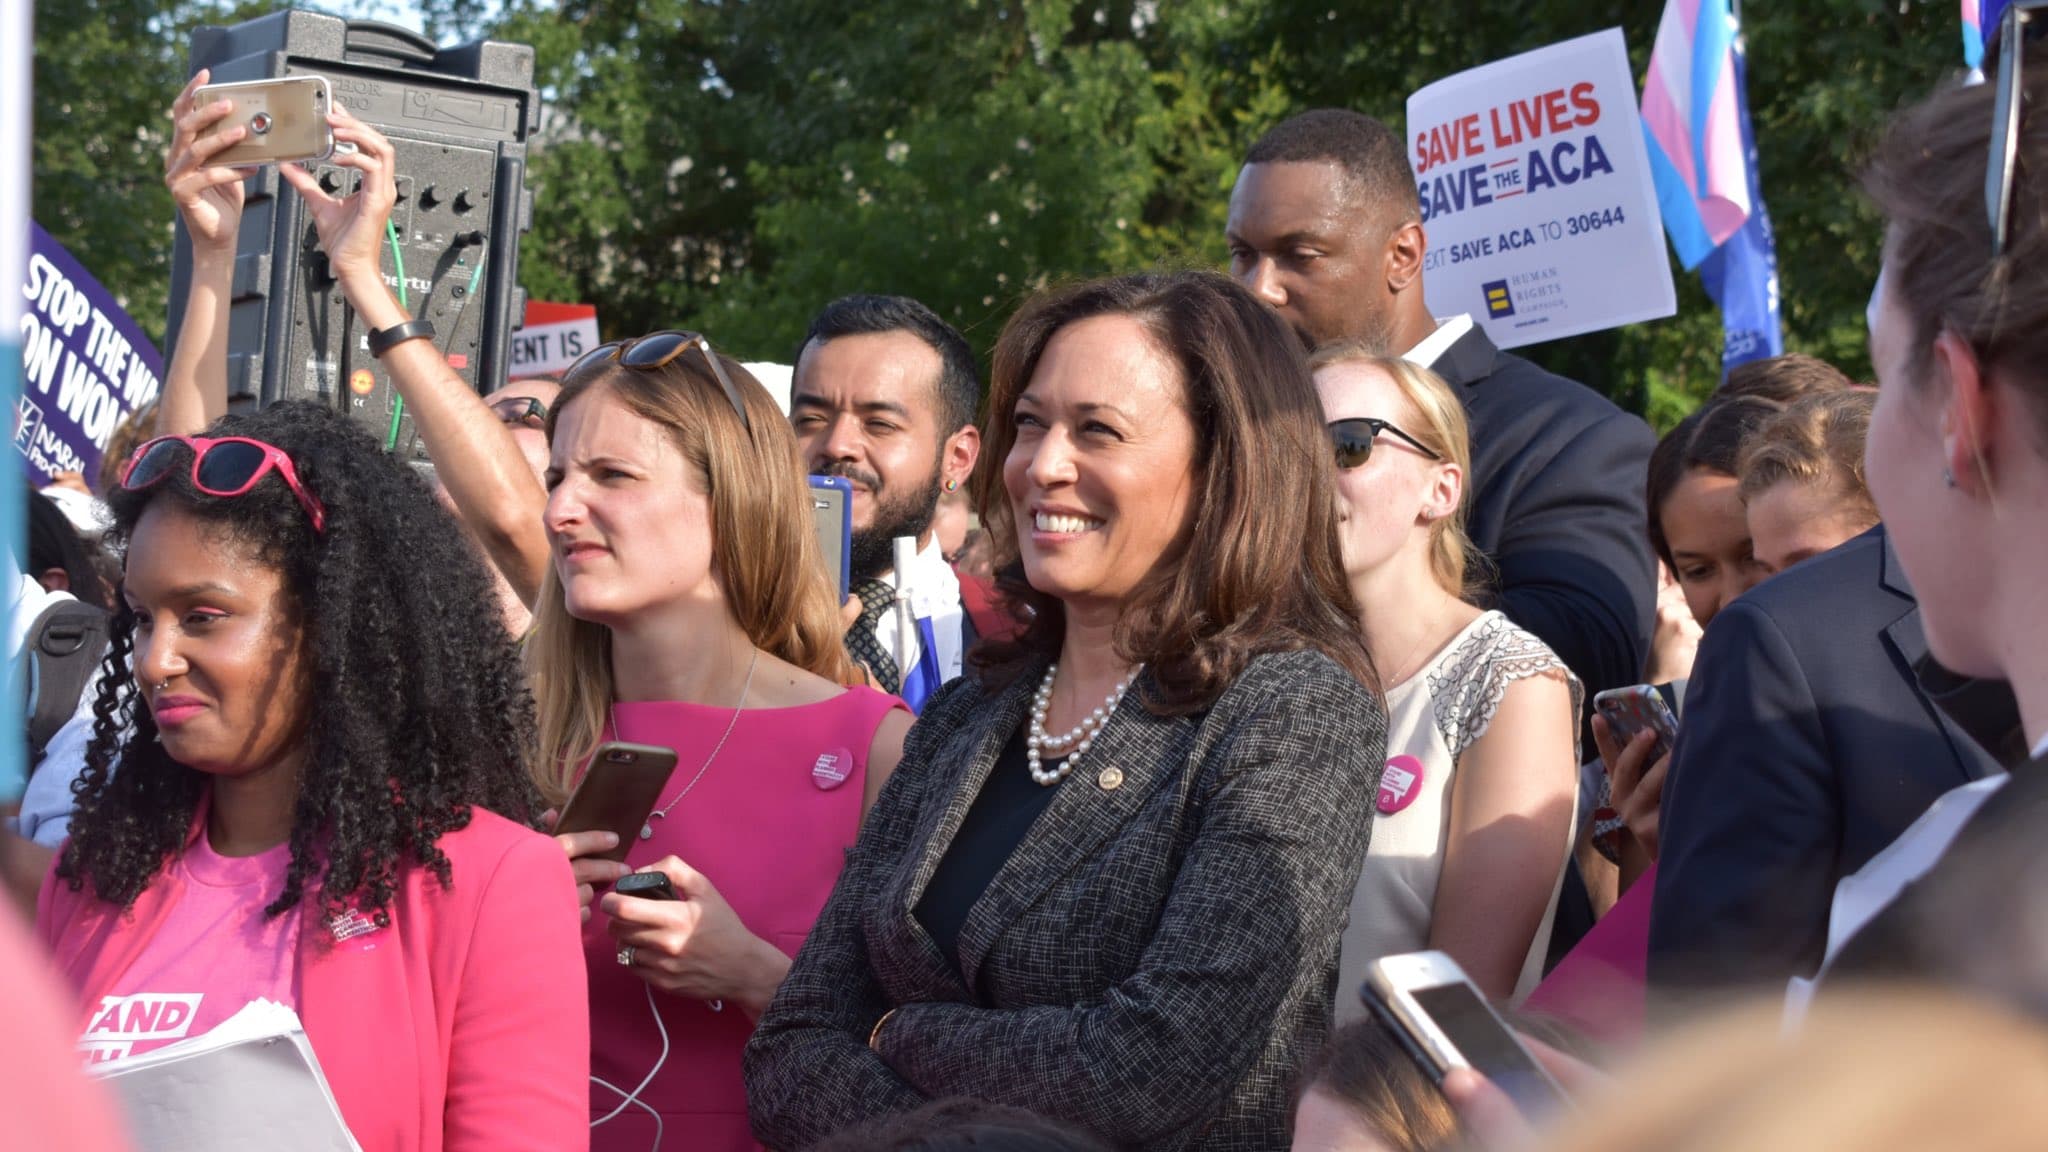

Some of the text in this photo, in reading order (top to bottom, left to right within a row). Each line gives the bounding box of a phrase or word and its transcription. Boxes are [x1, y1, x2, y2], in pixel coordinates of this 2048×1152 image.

[1417, 82, 1600, 174] SAVE LIVES
[1420, 135, 1614, 223] SAVE THE ACA
[1426, 206, 1625, 271] EXT SAVE ACA TO 30644
[20, 312, 64, 395] ON
[23, 253, 90, 338] STOP
[85, 307, 132, 389] THE
[513, 331, 582, 364] ENT IS
